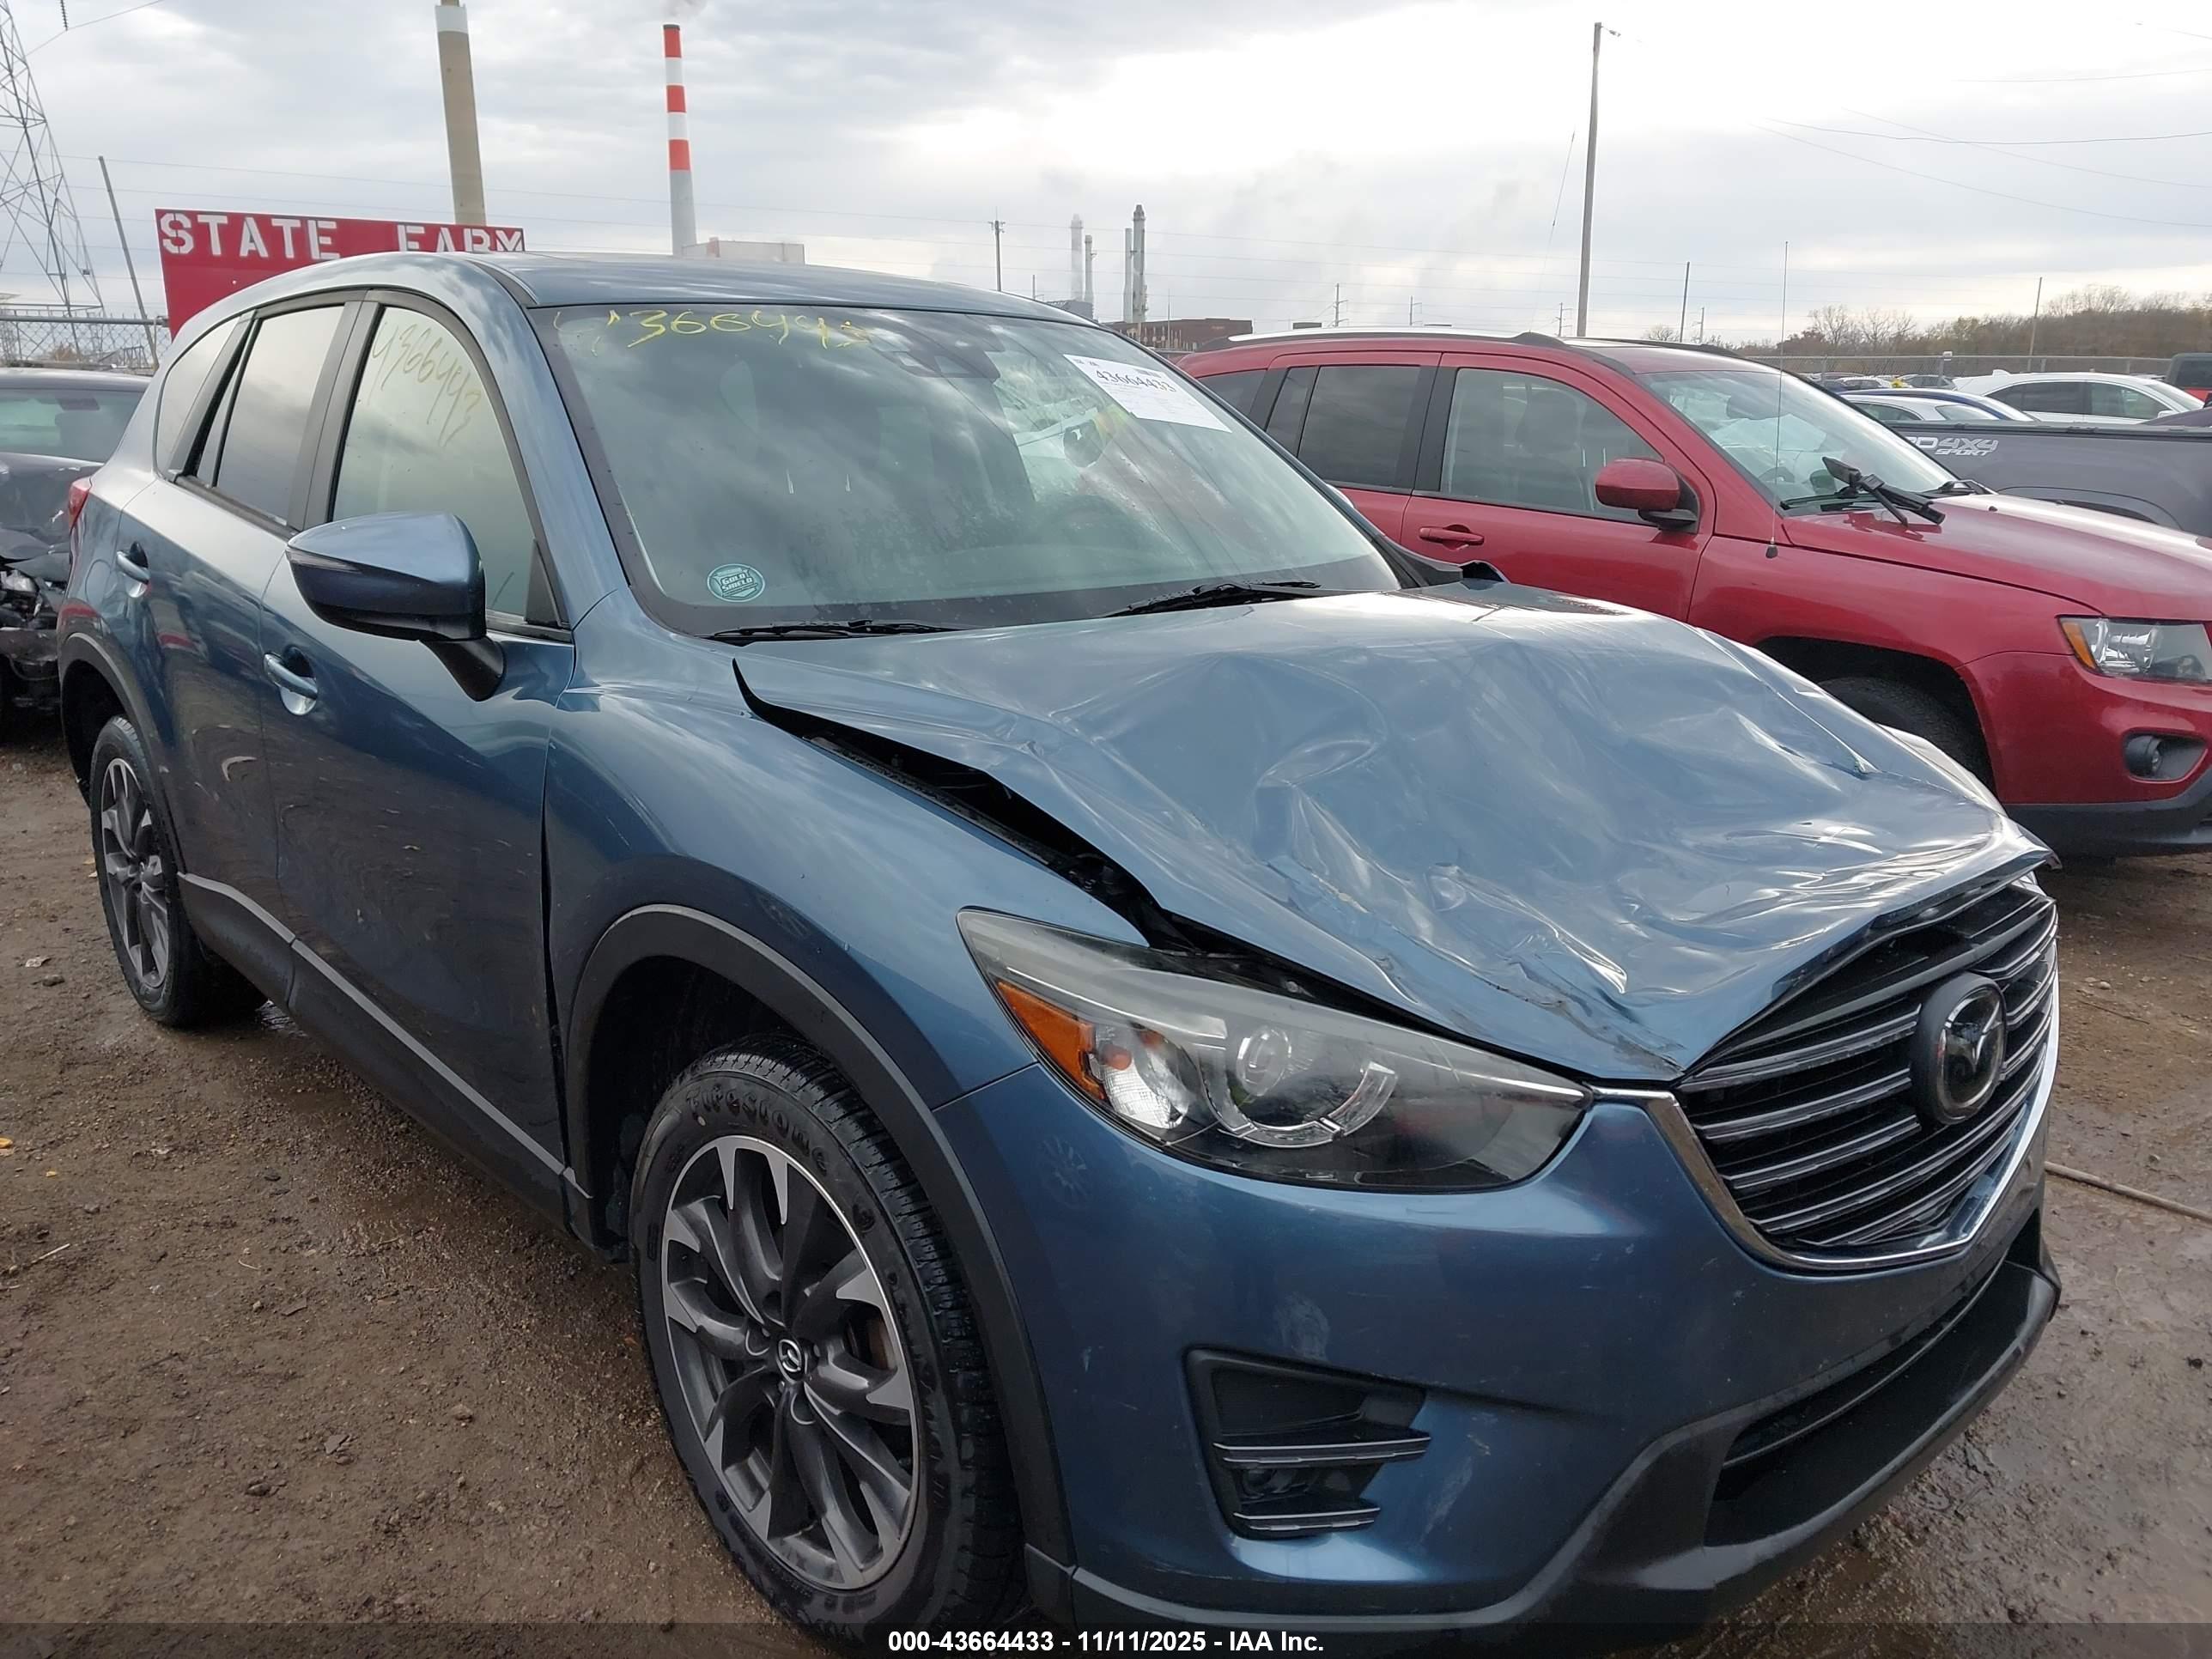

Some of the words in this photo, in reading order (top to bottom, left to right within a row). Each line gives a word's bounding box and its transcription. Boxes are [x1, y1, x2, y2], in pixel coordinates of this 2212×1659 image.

[160, 212, 341, 259] STATE
[397, 224, 523, 252] FARM
[1095, 369, 1177, 392] 43664433
